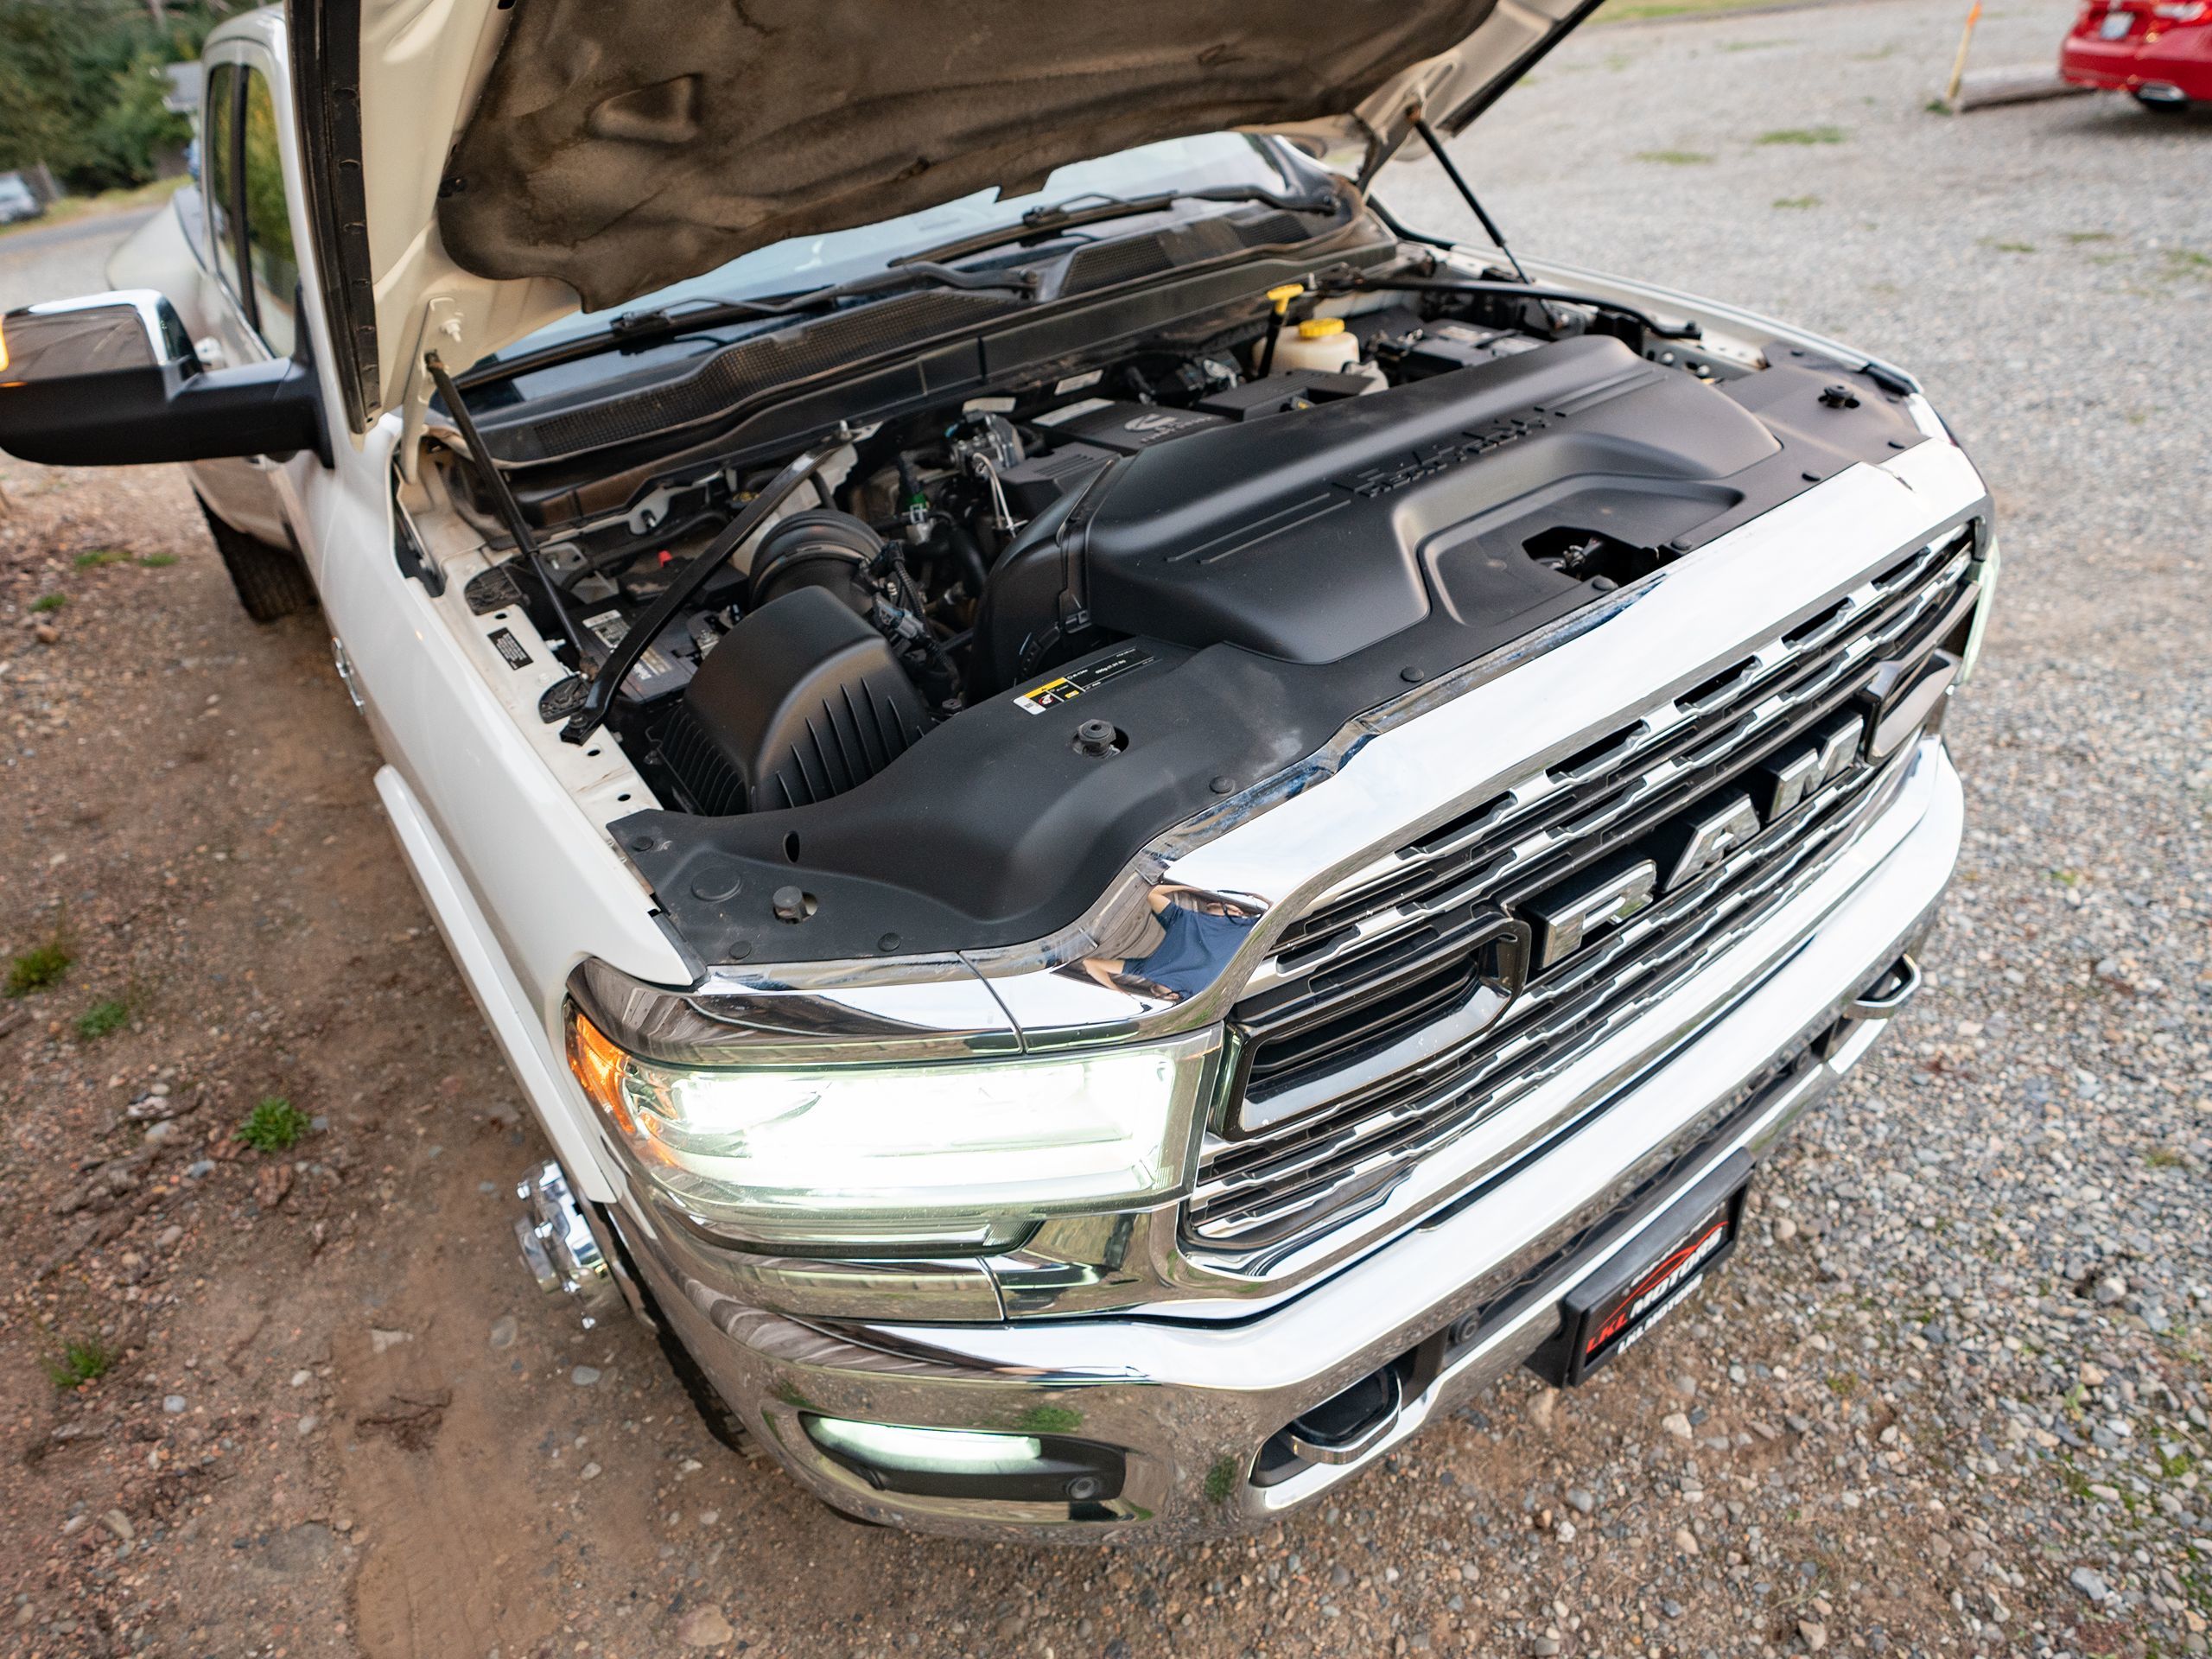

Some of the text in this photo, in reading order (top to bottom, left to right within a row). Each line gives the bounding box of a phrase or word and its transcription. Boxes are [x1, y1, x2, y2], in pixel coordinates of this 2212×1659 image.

[1539, 715, 1864, 969] RAM
[1585, 1313, 1628, 1355] LKL
[1629, 1227, 1723, 1319] MOTORS
[1644, 1273, 1703, 1332] MOTORS
